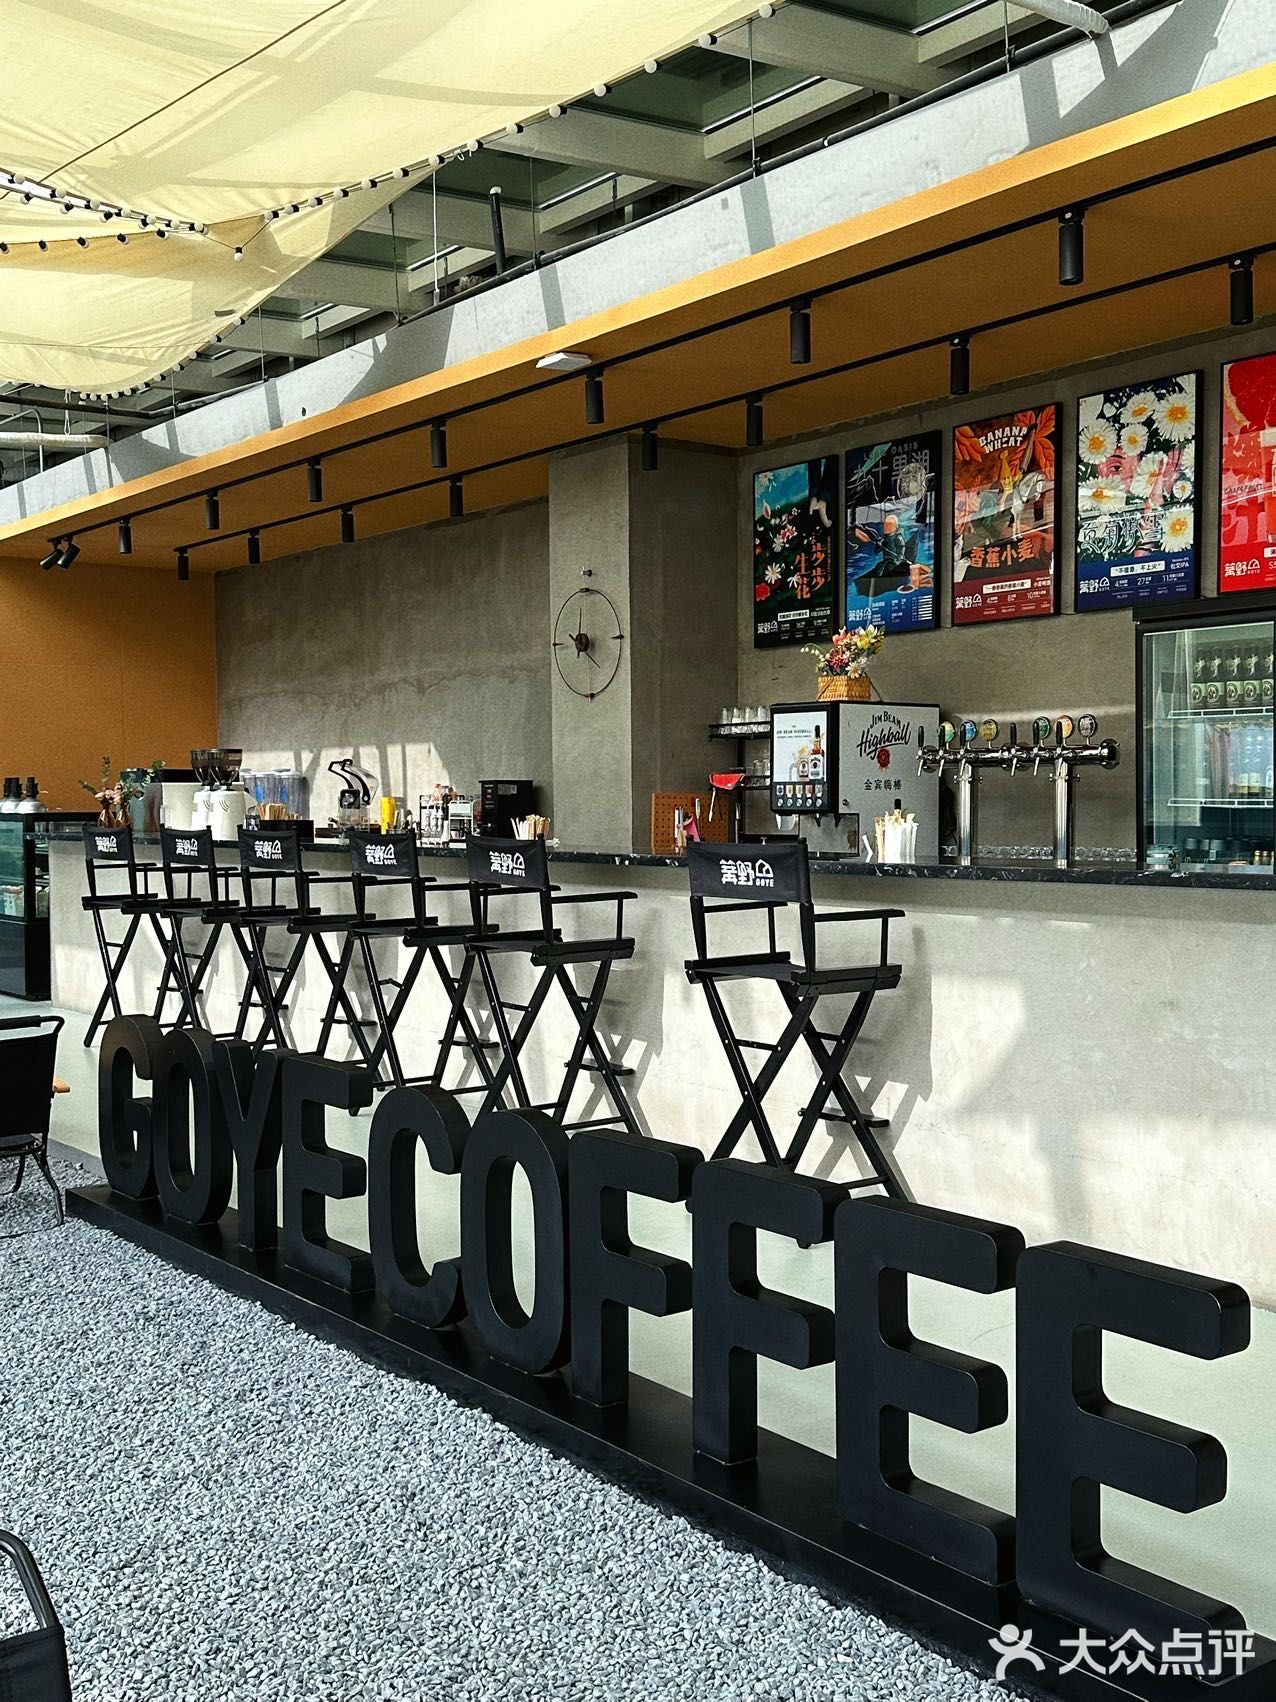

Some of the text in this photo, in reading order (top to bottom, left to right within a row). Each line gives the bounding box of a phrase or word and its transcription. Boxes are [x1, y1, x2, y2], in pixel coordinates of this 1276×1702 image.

[970, 538, 1035, 568] 香蕉小麦
[870, 711, 901, 729] JIM BEAM
[856, 721, 912, 761] Highball
[864, 778, 903, 791] 金宾嗨棒
[755, 878, 775, 888] GOYE
